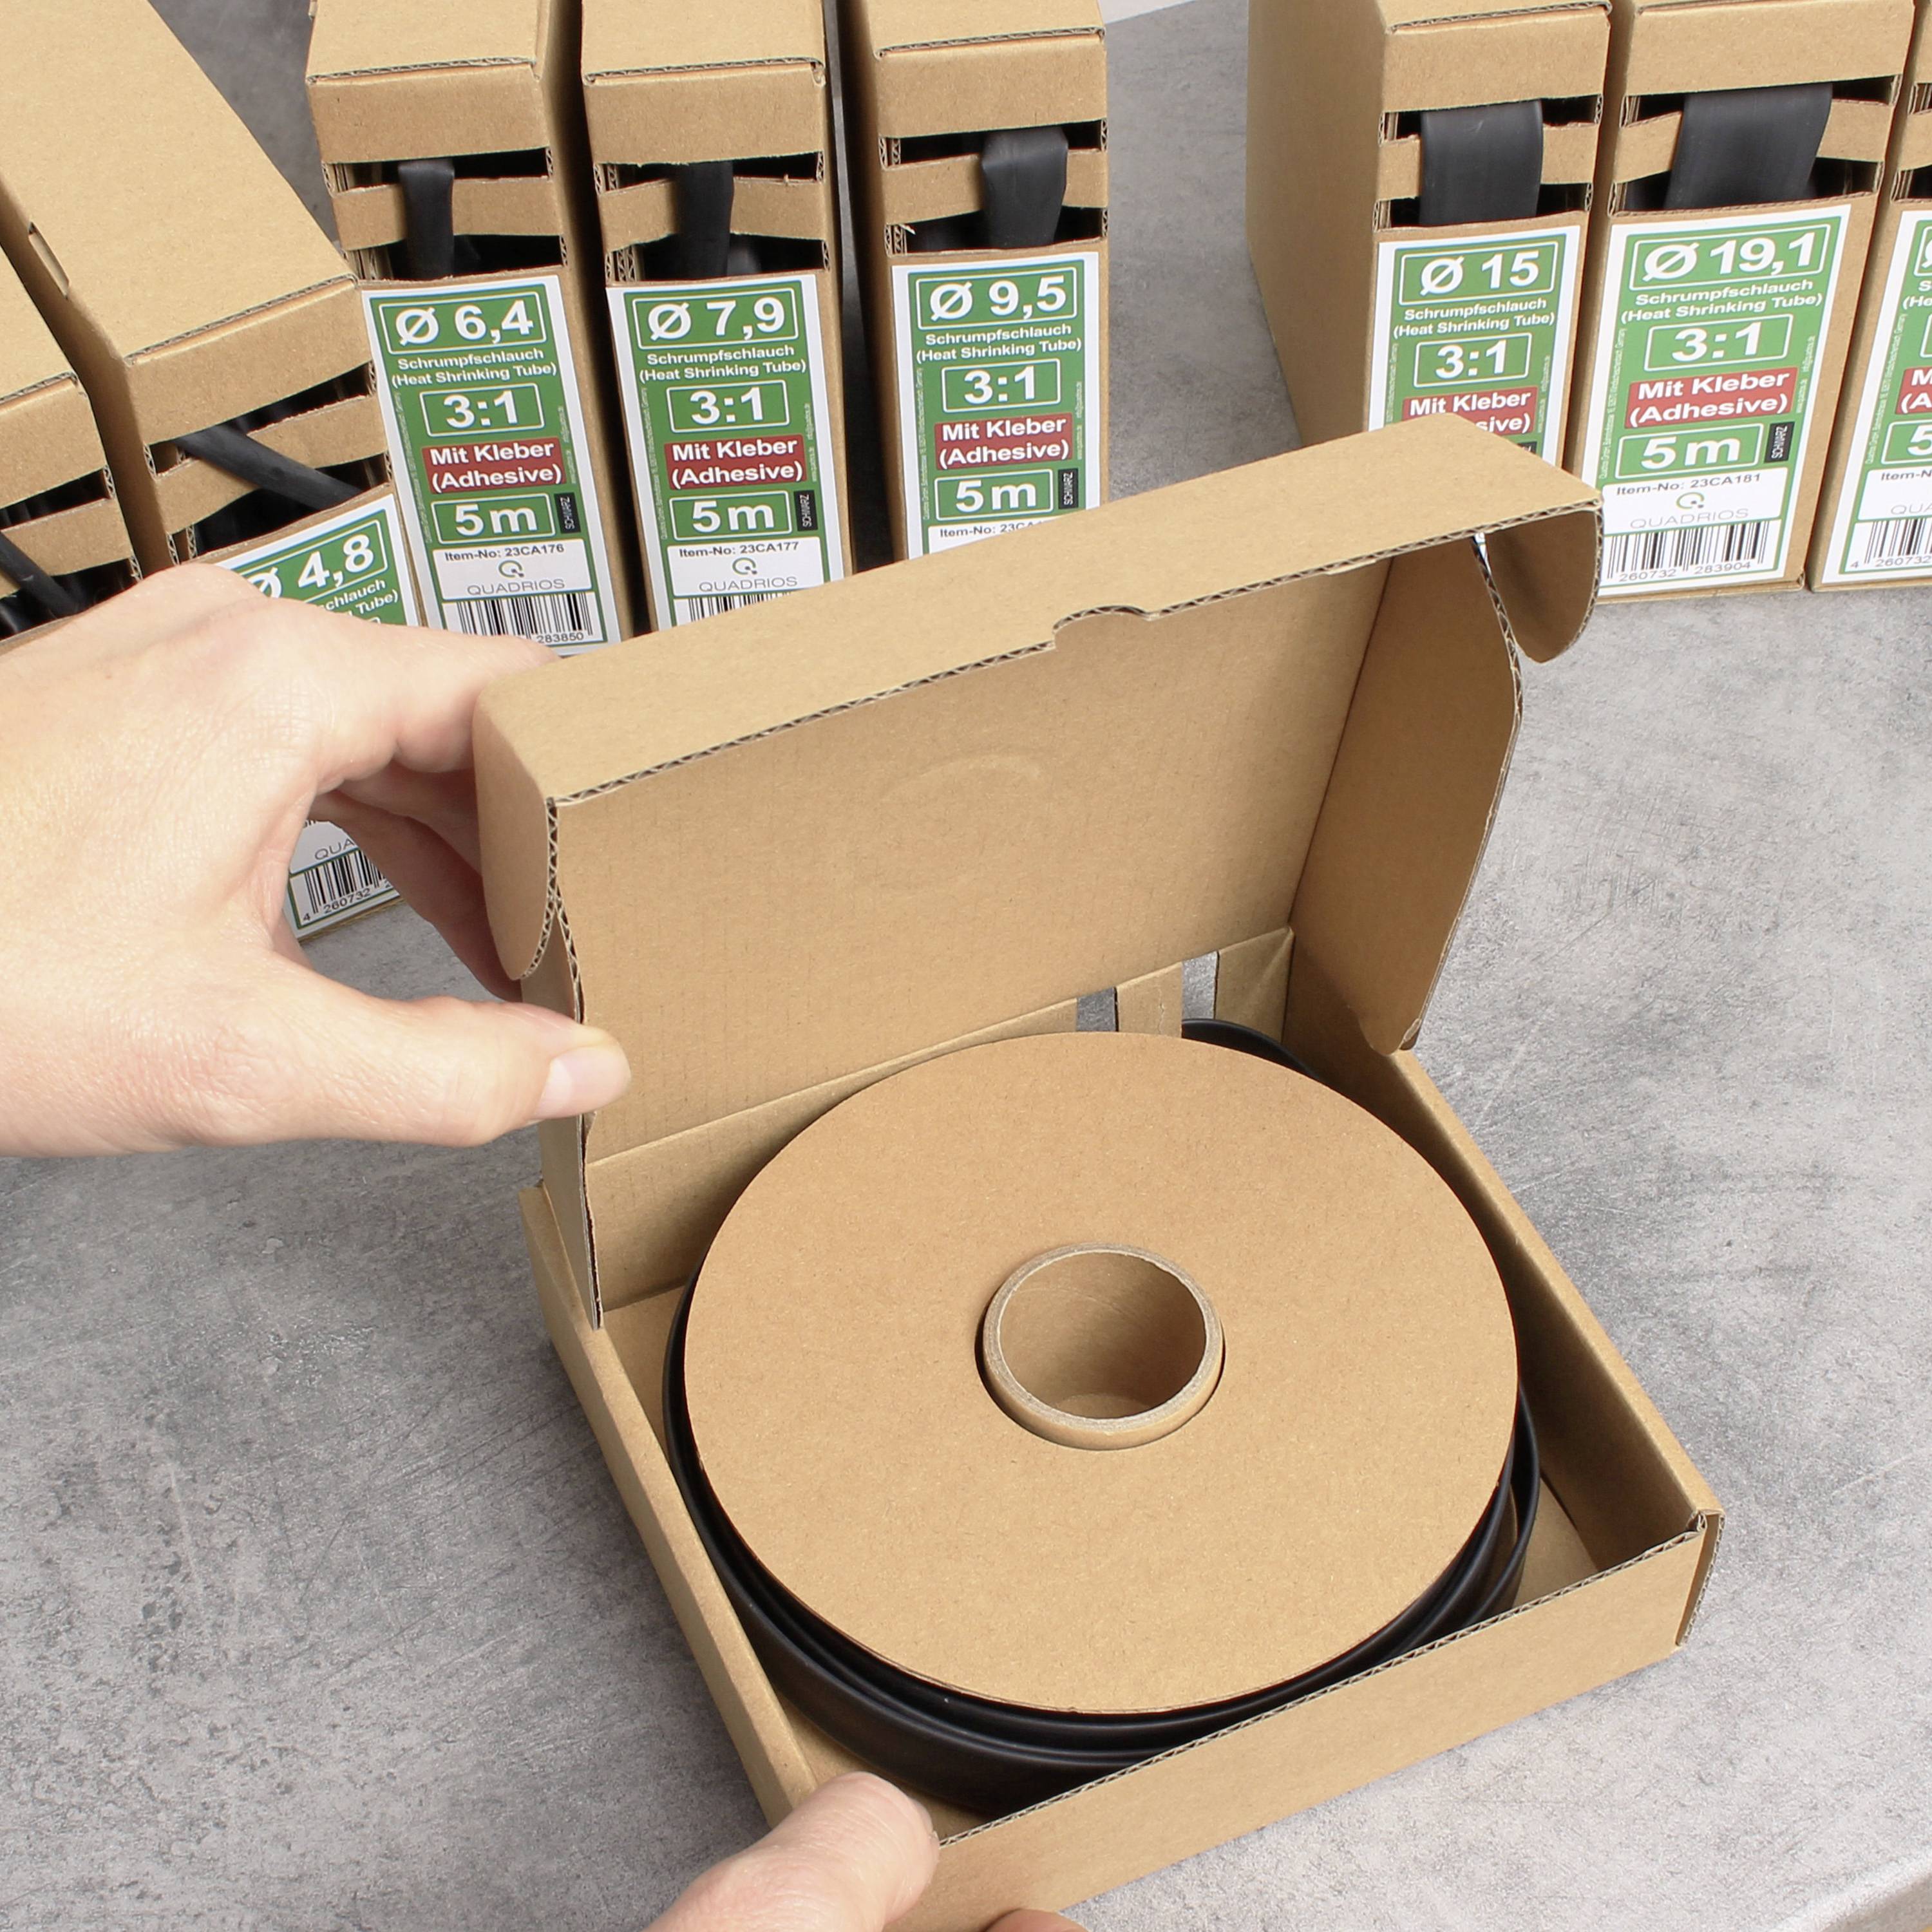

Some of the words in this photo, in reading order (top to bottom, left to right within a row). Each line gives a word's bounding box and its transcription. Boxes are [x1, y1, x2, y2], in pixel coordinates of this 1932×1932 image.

[1709, 232, 1815, 275] 19,1
[1482, 251, 1539, 289] 15
[989, 275, 1066, 319] 9,5
[1636, 279, 1814, 306] Schrumpfschlauch
[706, 297, 785, 340] 7,9
[1404, 298, 1546, 321] Schrumpfschlauch
[1622, 307, 1671, 324] (Heat
[1675, 298, 1765, 318] Shrinking
[1773, 292, 1823, 308] Tube)
[455, 300, 533, 344] 6,4
[925, 323, 1071, 345] Schrumpfschlauch
[1393, 324, 1433, 339] (Heat
[1437, 318, 1510, 334] Shrinking
[1514, 312, 1555, 326] Tube)
[916, 348, 956, 364] (Heat
[961, 343, 1035, 358] Shrinking
[1039, 338, 1082, 352] Tube)
[1672, 322, 1761, 362] 3:1
[398, 347, 544, 370] Schrumpfschlauch
[647, 345, 795, 365] Schrumpfschlauch
[1435, 339, 1507, 379] 3:1
[392, 368, 433, 388] (Heat
[435, 367, 511, 384] Shrinking
[513, 362, 557, 377] Tube)
[639, 368, 681, 384] (Heat
[684, 364, 759, 378] Shrinking
[762, 359, 807, 374] Tube)
[965, 366, 1035, 405] 3:1
[1638, 380, 1684, 400] Mit
[1692, 371, 1790, 394] Kleber
[443, 390, 519, 428] 3:1
[690, 388, 763, 425] 3:1
[1410, 399, 1445, 416] Mit
[1453, 392, 1531, 412] Kleber
[1630, 393, 1788, 428] (Adhesive)
[942, 424, 980, 442] Mit
[987, 417, 1066, 437] Kleber
[430, 447, 468, 466] Mit
[474, 442, 554, 462] Kleber
[672, 444, 711, 461] Mit
[716, 439, 797, 459] Kleber
[940, 439, 1069, 469] (Adhesive)
[432, 464, 562, 494] (Adhesive)
[671, 460, 802, 488] (Adhesive)
[1616, 481, 1684, 495] Item-No:
[1689, 473, 1761, 488] 23CA181
[1881, 470, 1932, 480] Item-N
[1630, 508, 1748, 528] QUADRIOS
[940, 526, 996, 538] Item-No:
[298, 535, 374, 587] 4,8
[445, 549, 502, 562] Item-No:
[504, 544, 564, 556] 23CA176
[679, 545, 735, 558] Item-No:
[739, 542, 799, 554] 23CA177
[699, 576, 798, 592] QUADRIOS
[1619, 569, 1676, 582] 260732
[1694, 562, 1751, 574] 283904
[320, 580, 386, 611] chlauch
[467, 578, 565, 596] QUADRIOS
[356, 589, 399, 614] Tube)
[536, 632, 583, 643] 283850
[314, 838, 354, 860] QUA
[323, 888, 371, 913] 260732
